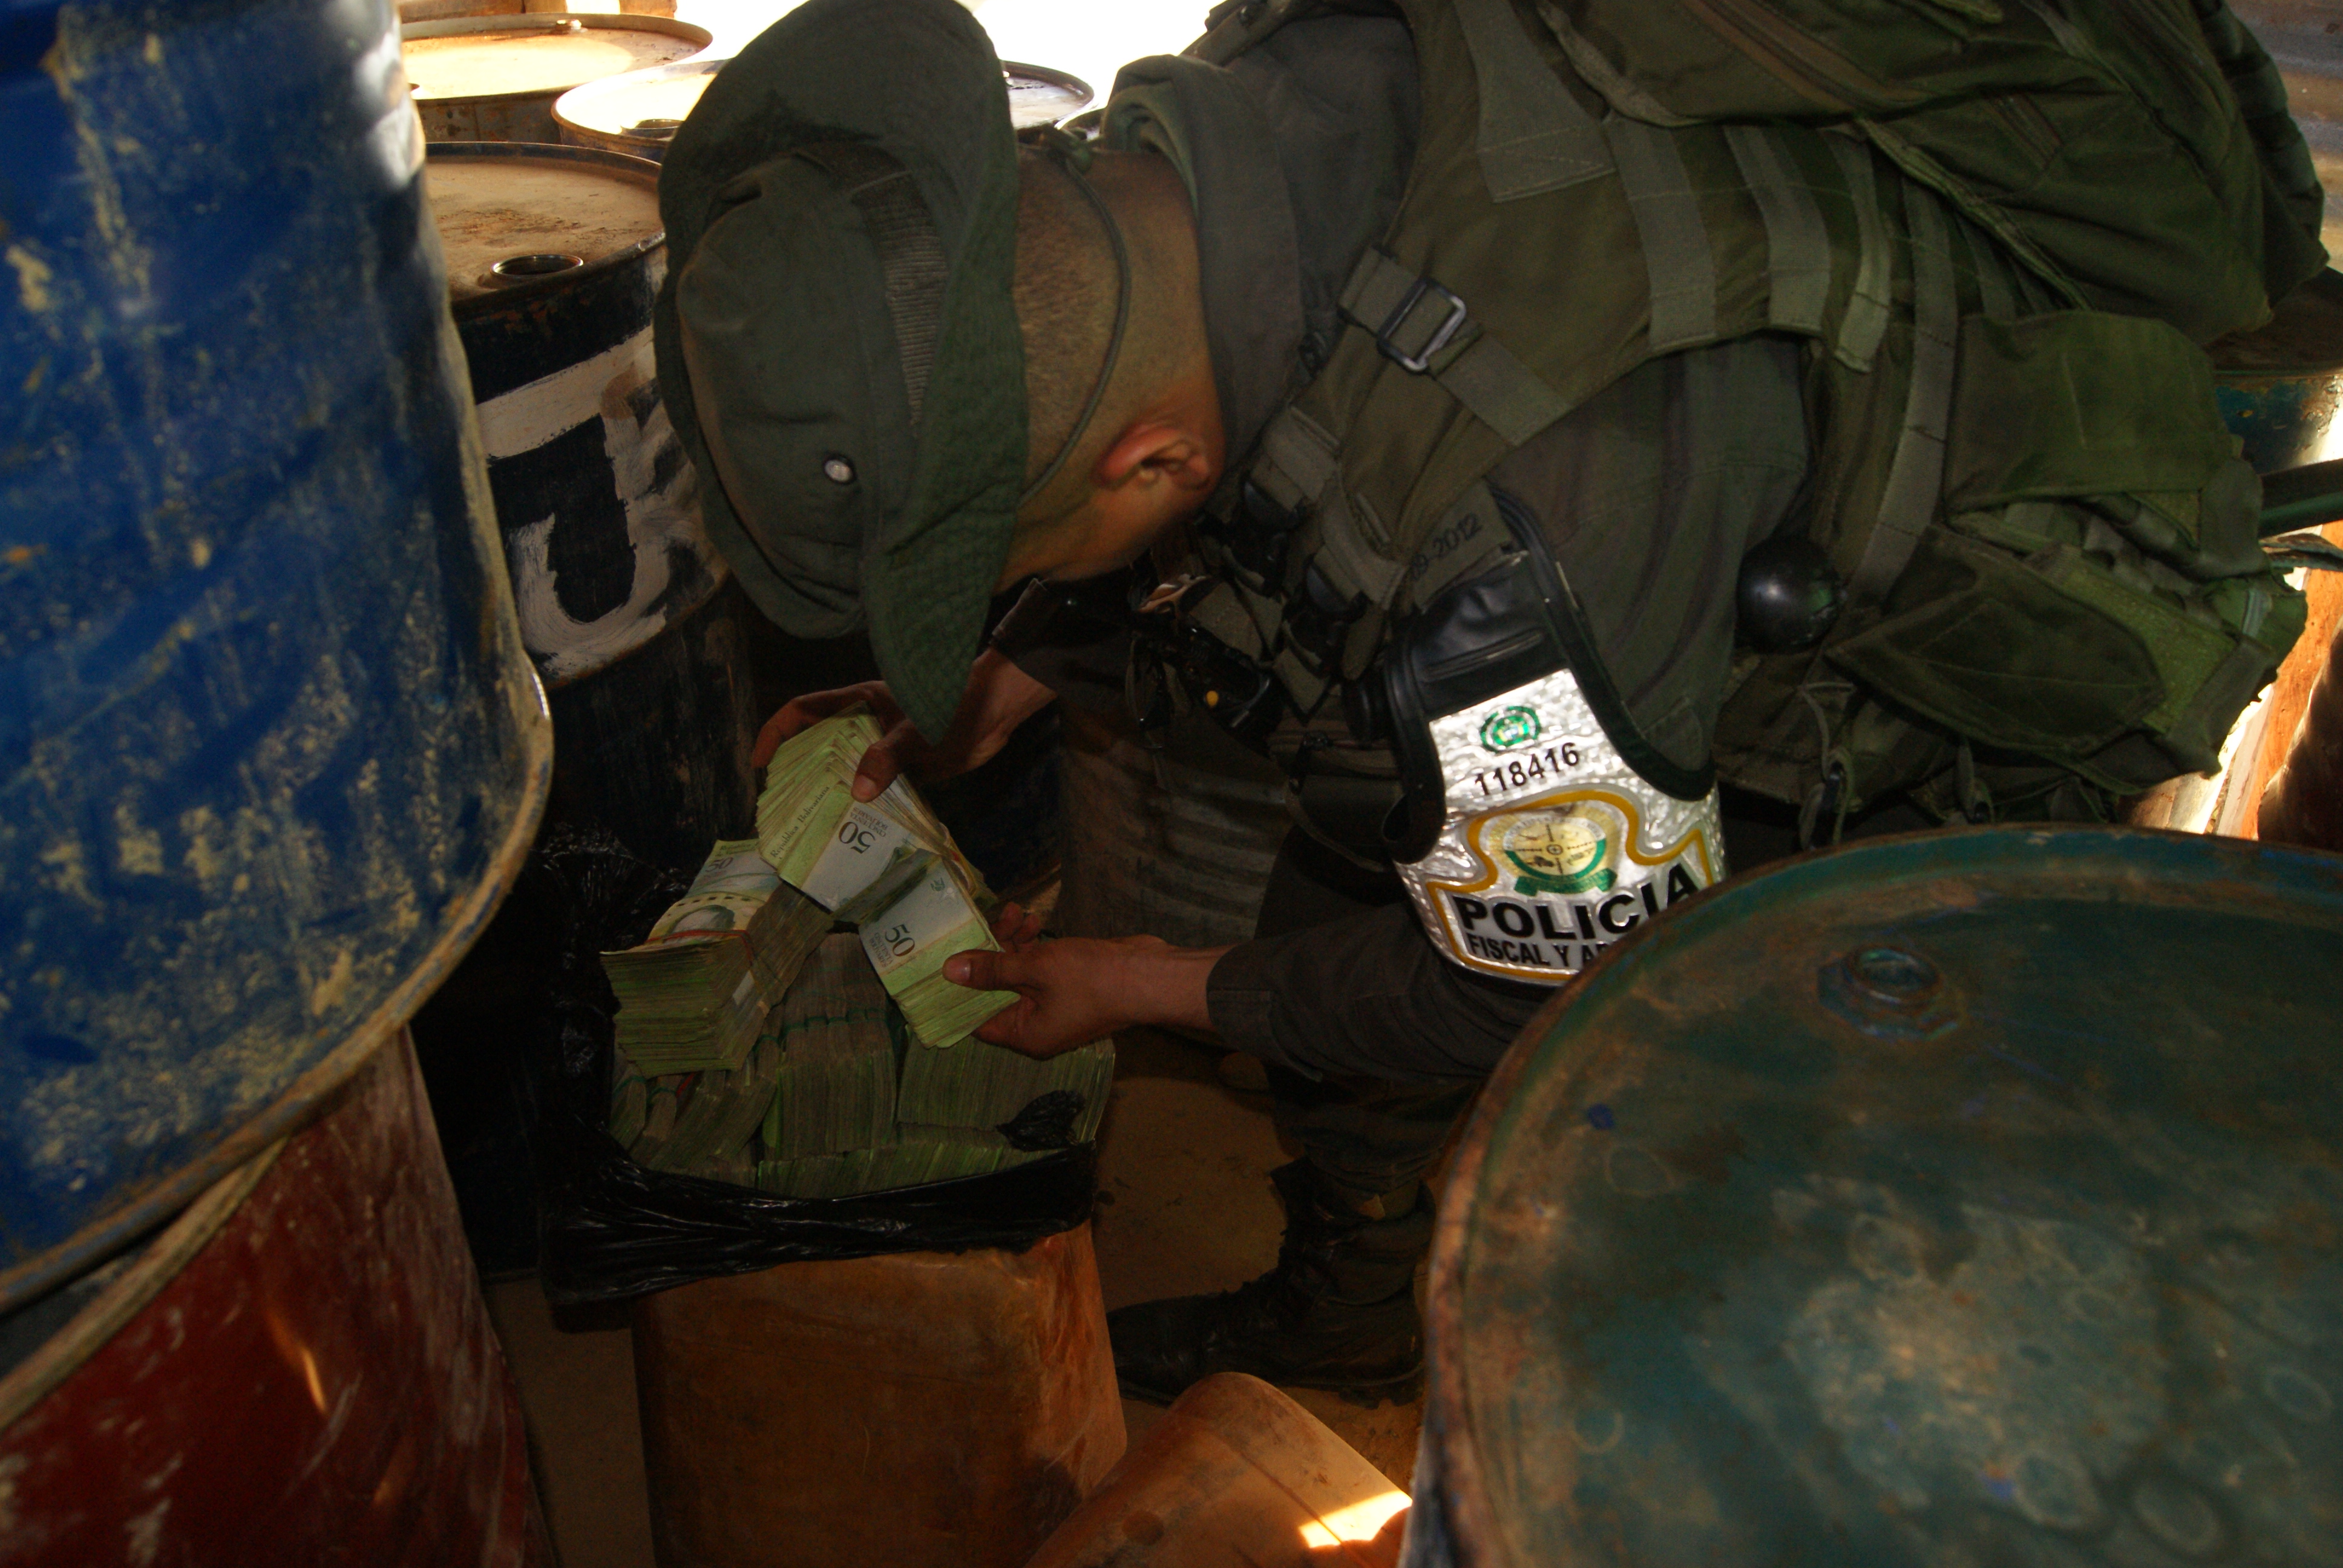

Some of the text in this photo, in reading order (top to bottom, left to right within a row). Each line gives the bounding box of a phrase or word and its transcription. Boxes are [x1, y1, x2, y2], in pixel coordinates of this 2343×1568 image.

[1475, 742, 1579, 795] 118416
[839, 822, 876, 854] 50
[705, 857, 733, 872] 50
[1453, 864, 1698, 940] POLICIA
[885, 924, 915, 957] 50
[1466, 932, 1550, 966] FISCAL
[1554, 944, 1569, 967] Y
